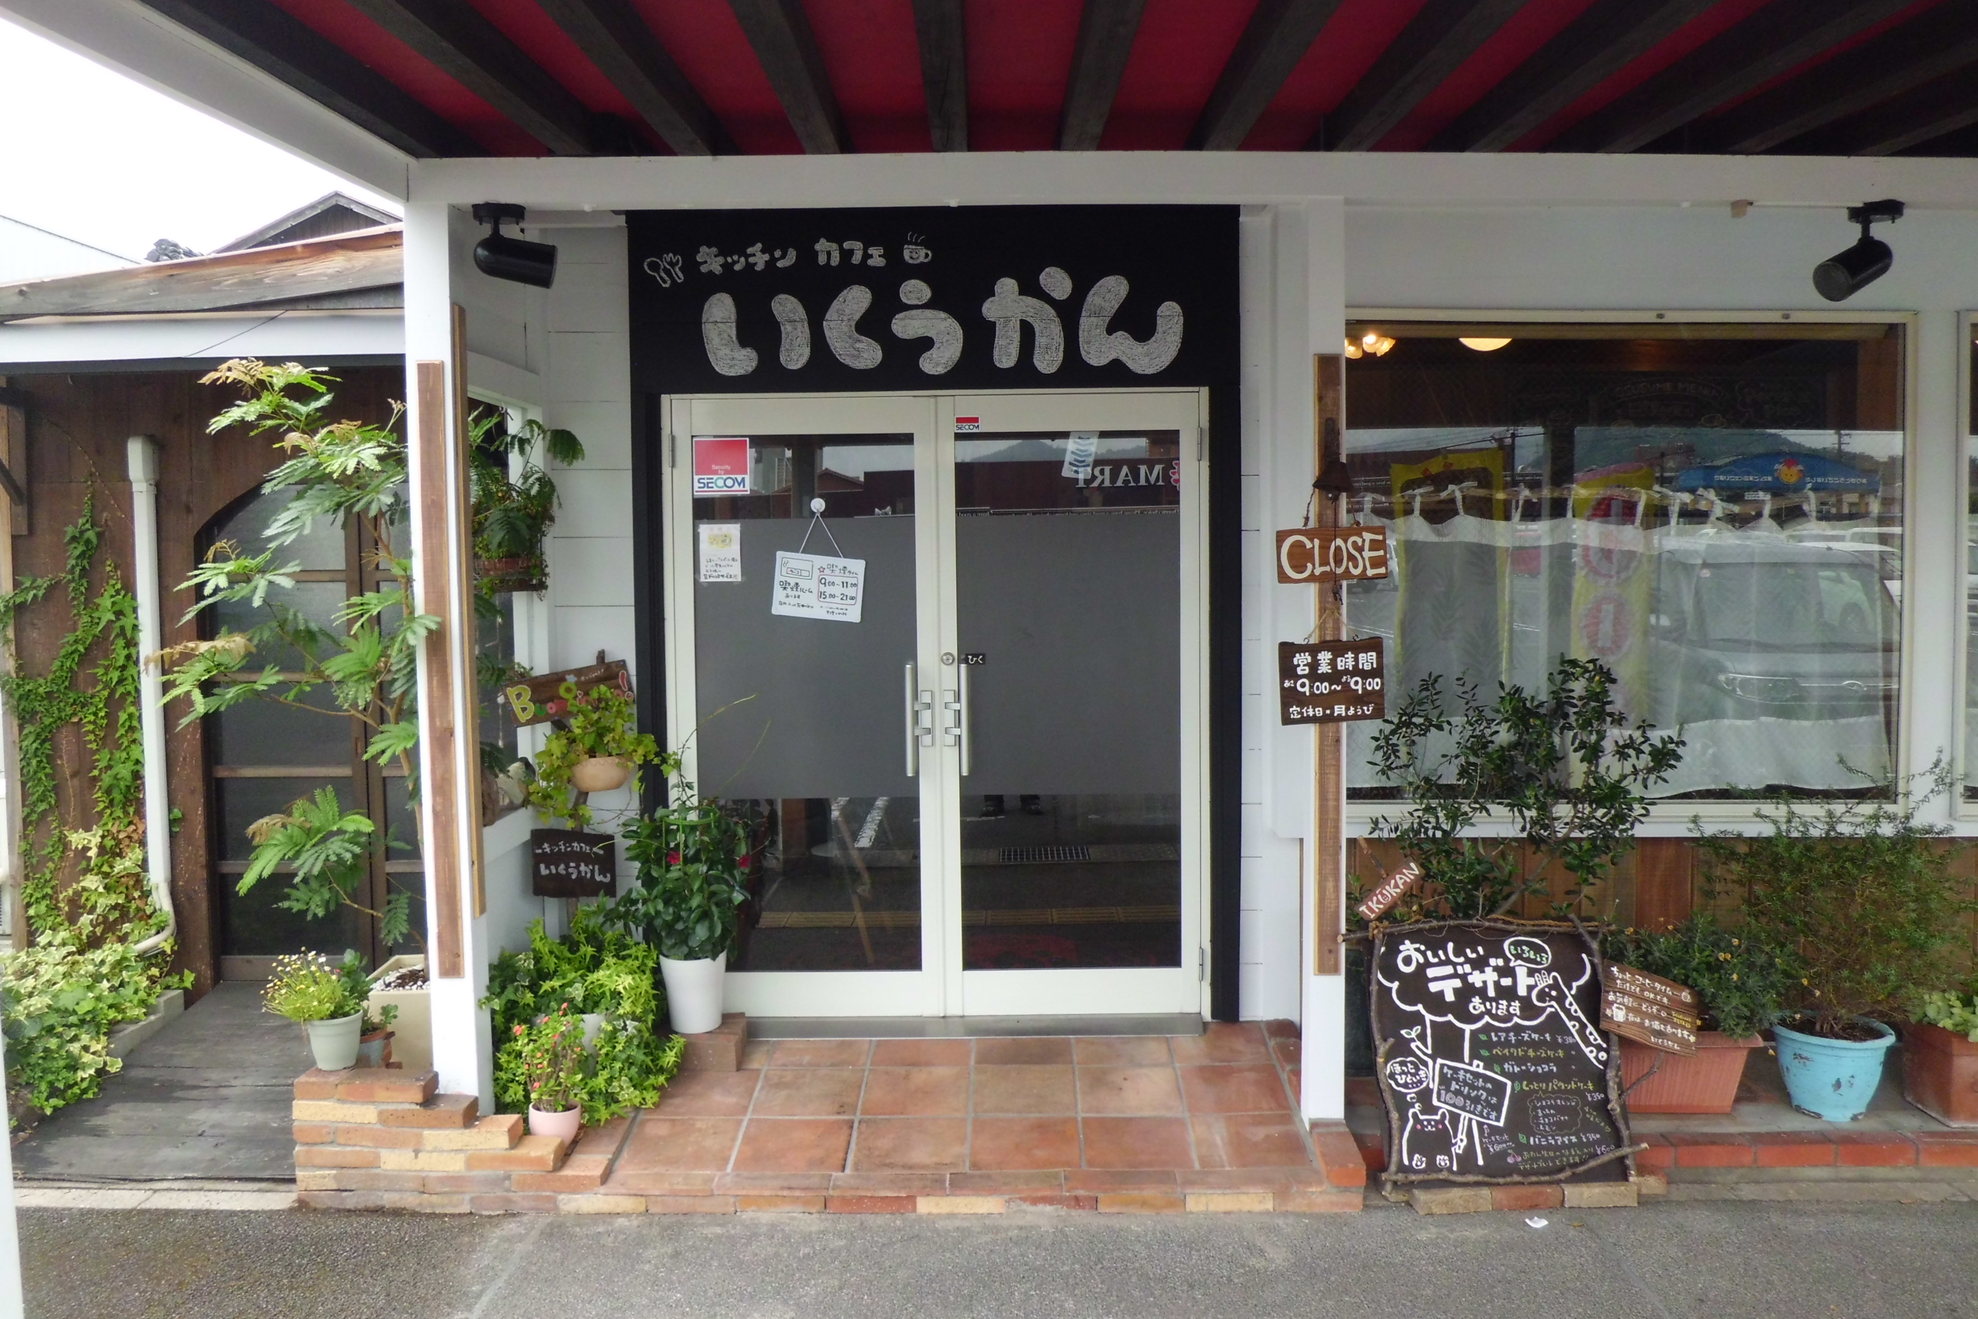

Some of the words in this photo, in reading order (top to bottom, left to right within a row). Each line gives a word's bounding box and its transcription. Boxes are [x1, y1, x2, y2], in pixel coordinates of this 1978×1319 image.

[697, 242, 797, 274] キッチン
[815, 238, 887, 268] カフェ
[701, 265, 1184, 376] いくうかん
[697, 476, 746, 489] SECOM
[1280, 532, 1386, 579] CLOSE
[967, 655, 984, 664] ひく
[1293, 651, 1377, 675] 営業時間
[540, 862, 611, 883] いくうかん
[1397, 939, 1484, 973] おいしい
[1426, 958, 1535, 1002] デザート
[1469, 996, 1521, 1016] あります
[1390, 1062, 1416, 1074] ほっと
